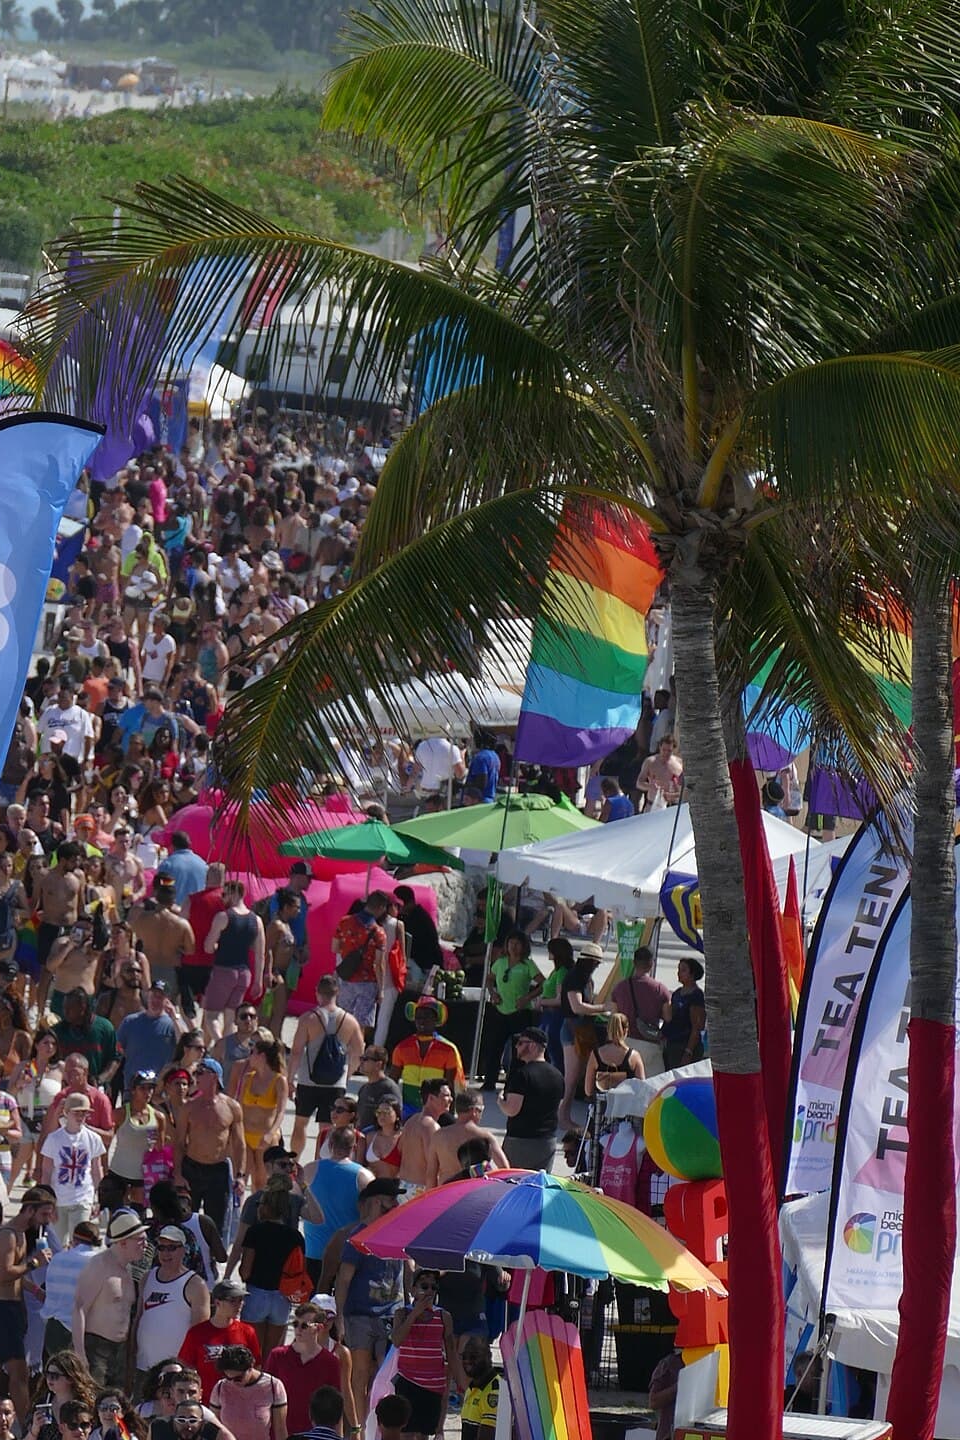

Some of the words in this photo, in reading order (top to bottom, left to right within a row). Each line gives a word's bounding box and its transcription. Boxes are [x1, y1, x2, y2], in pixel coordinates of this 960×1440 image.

[811, 972, 865, 1058] TEA
[806, 1109, 833, 1120] beach
[809, 1101, 835, 1112] miami
[802, 1115, 839, 1148] prid
